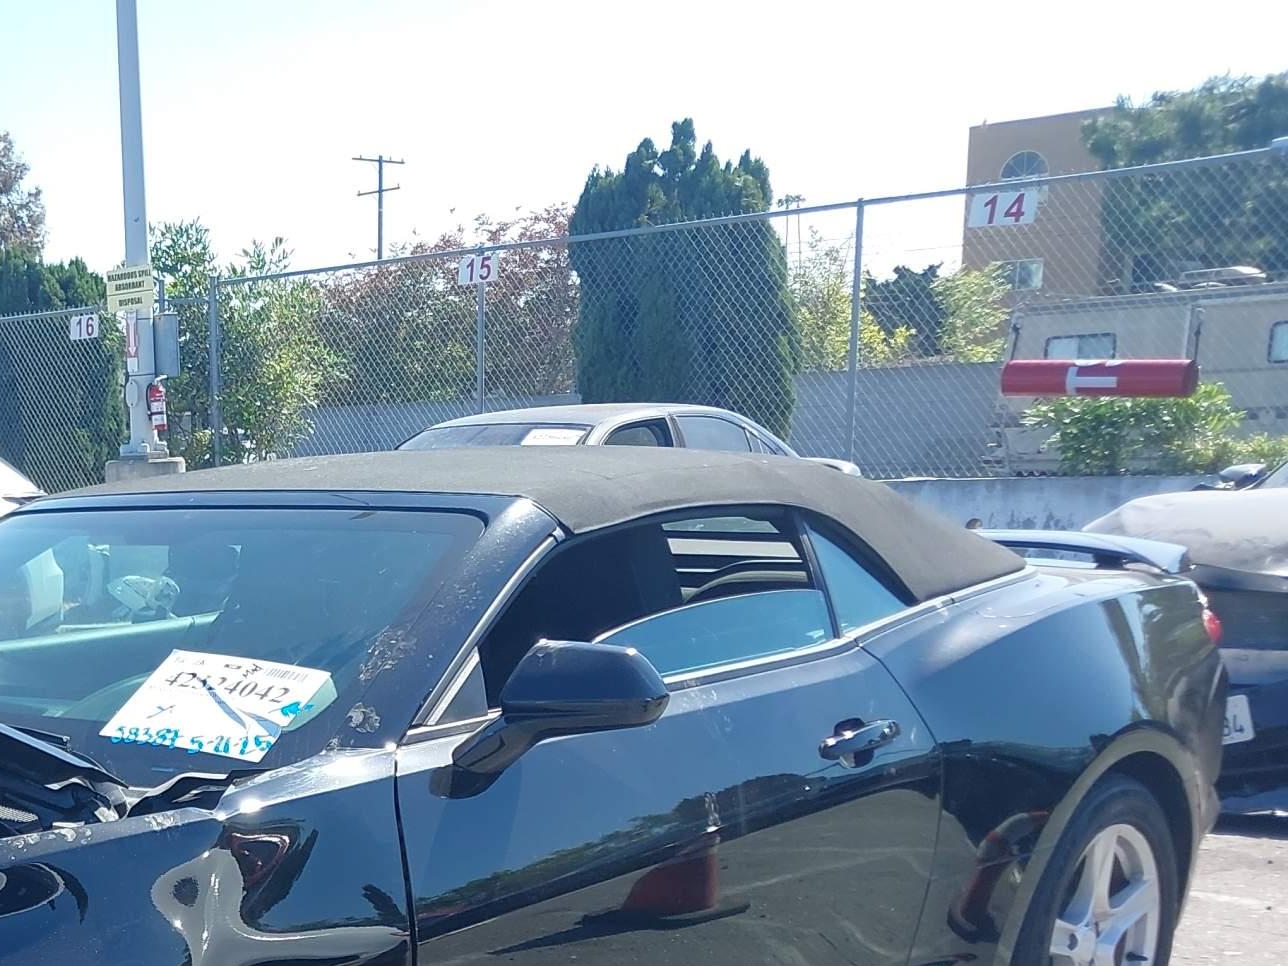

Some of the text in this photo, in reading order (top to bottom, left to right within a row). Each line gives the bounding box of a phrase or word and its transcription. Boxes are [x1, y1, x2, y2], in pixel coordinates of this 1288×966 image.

[984, 193, 1025, 225] 14
[108, 269, 151, 282] HAZARDOUS SPILL
[467, 256, 492, 281] 15
[119, 297, 143, 307] DISPOSAL
[76, 317, 94, 337] 16
